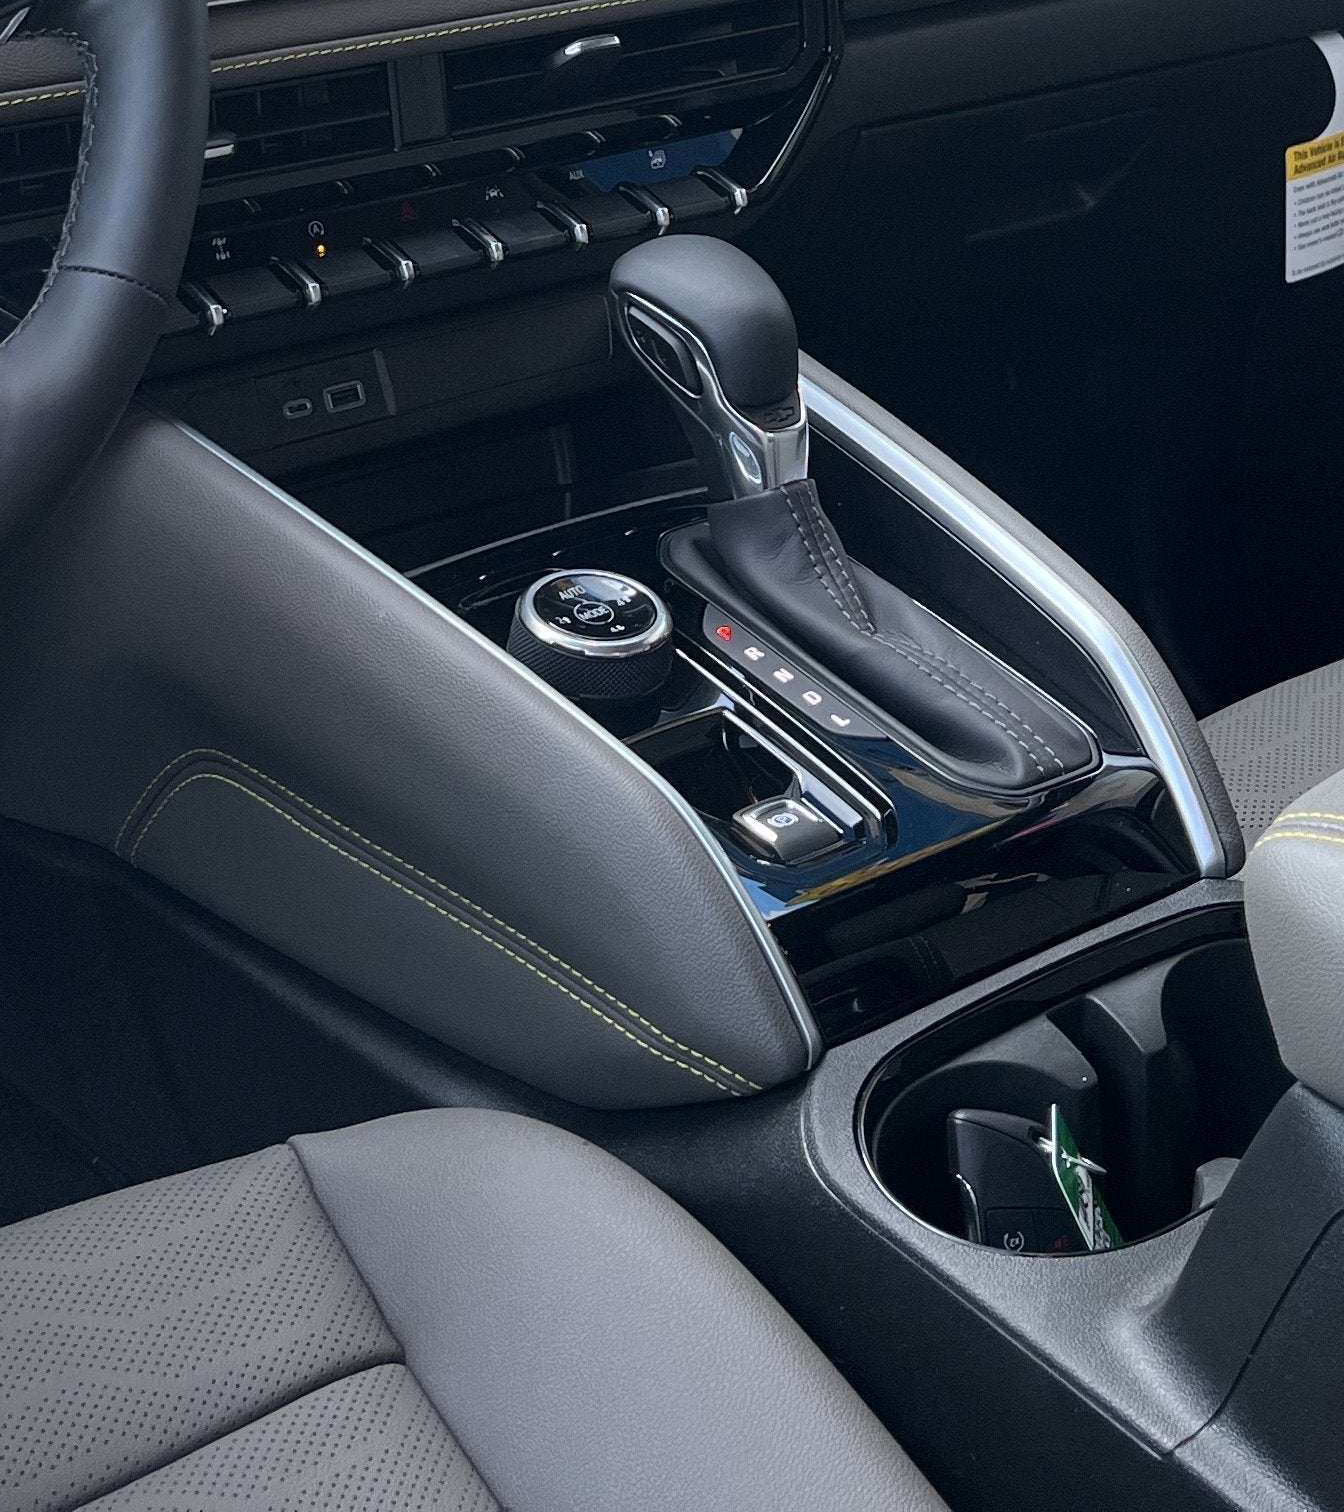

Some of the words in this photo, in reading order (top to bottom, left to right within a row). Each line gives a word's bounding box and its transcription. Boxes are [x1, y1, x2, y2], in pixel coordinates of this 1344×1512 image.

[558, 585, 586, 601] AUTO
[578, 606, 610, 621] MODE
[744, 646, 765, 661] R
[773, 667, 795, 683] N
[802, 690, 822, 706] D
[830, 714, 851, 728] L
